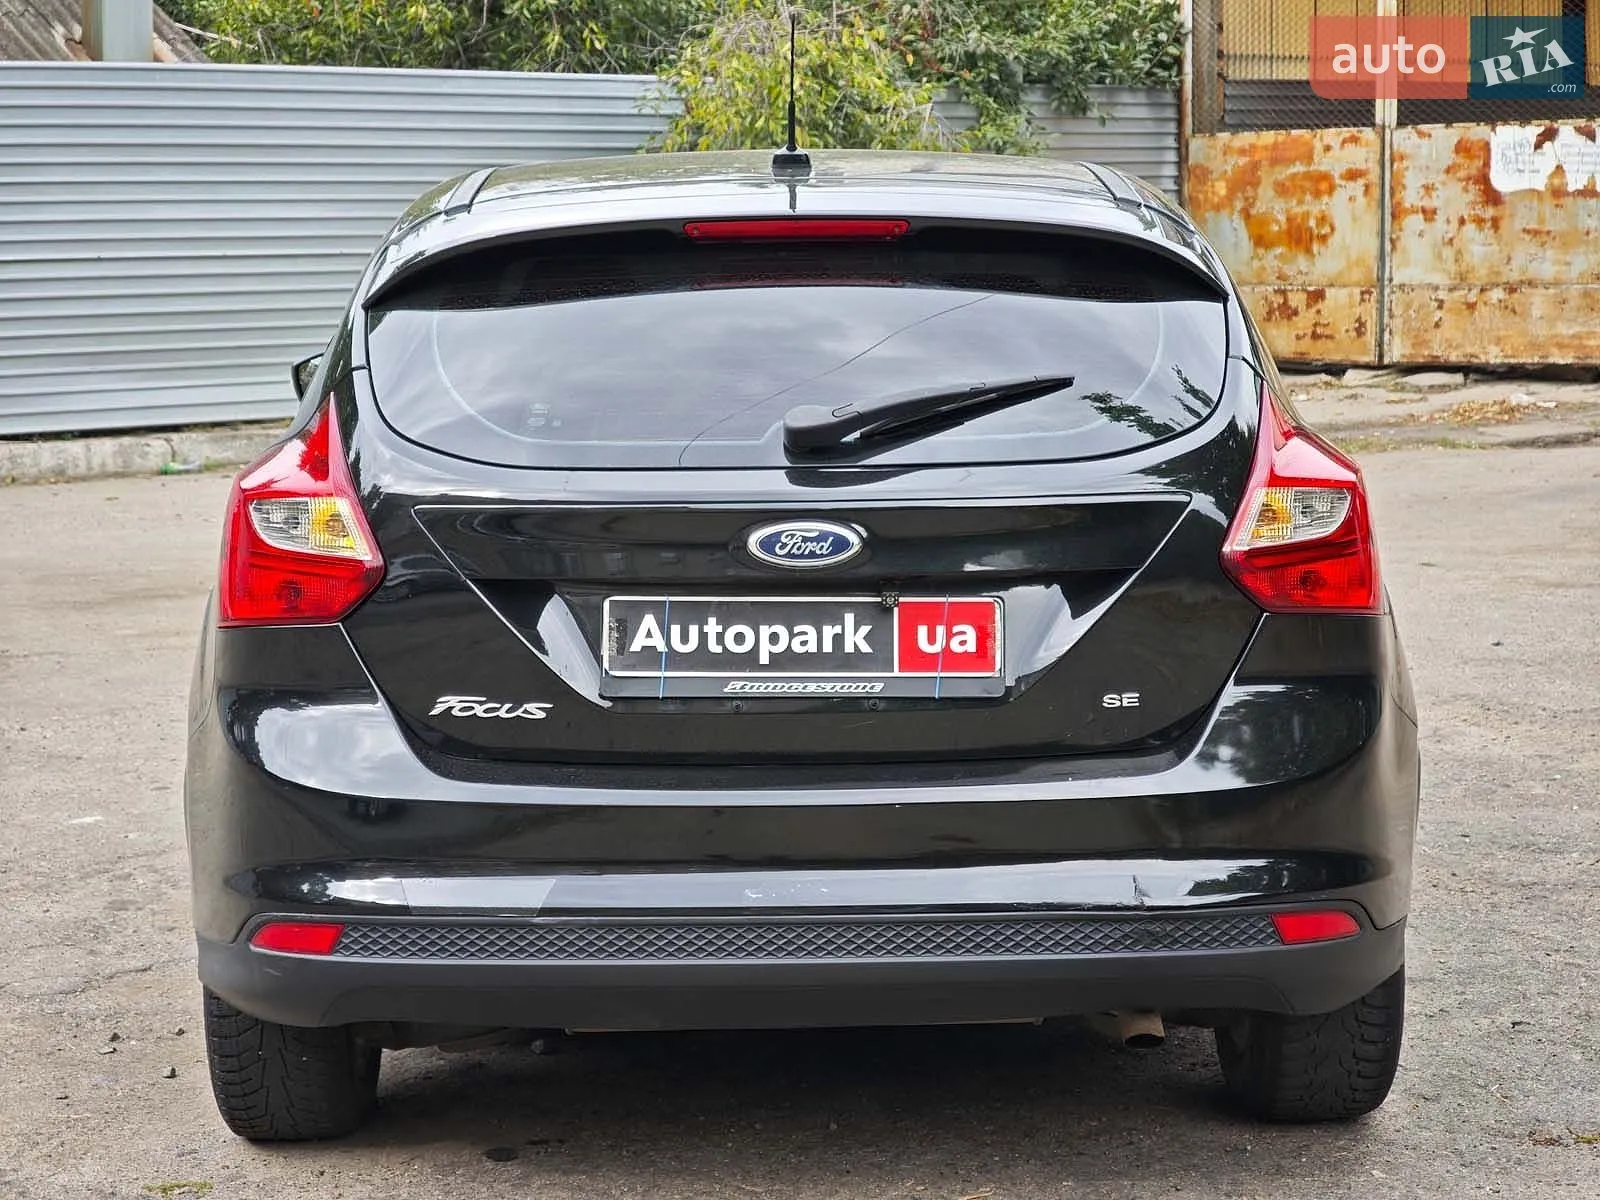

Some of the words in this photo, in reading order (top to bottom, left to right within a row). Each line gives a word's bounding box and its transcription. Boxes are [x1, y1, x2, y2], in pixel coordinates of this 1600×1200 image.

[775, 531, 834, 555] Ford
[629, 612, 873, 664] Autopark
[917, 624, 977, 654] ua
[1102, 692, 1140, 707] SE
